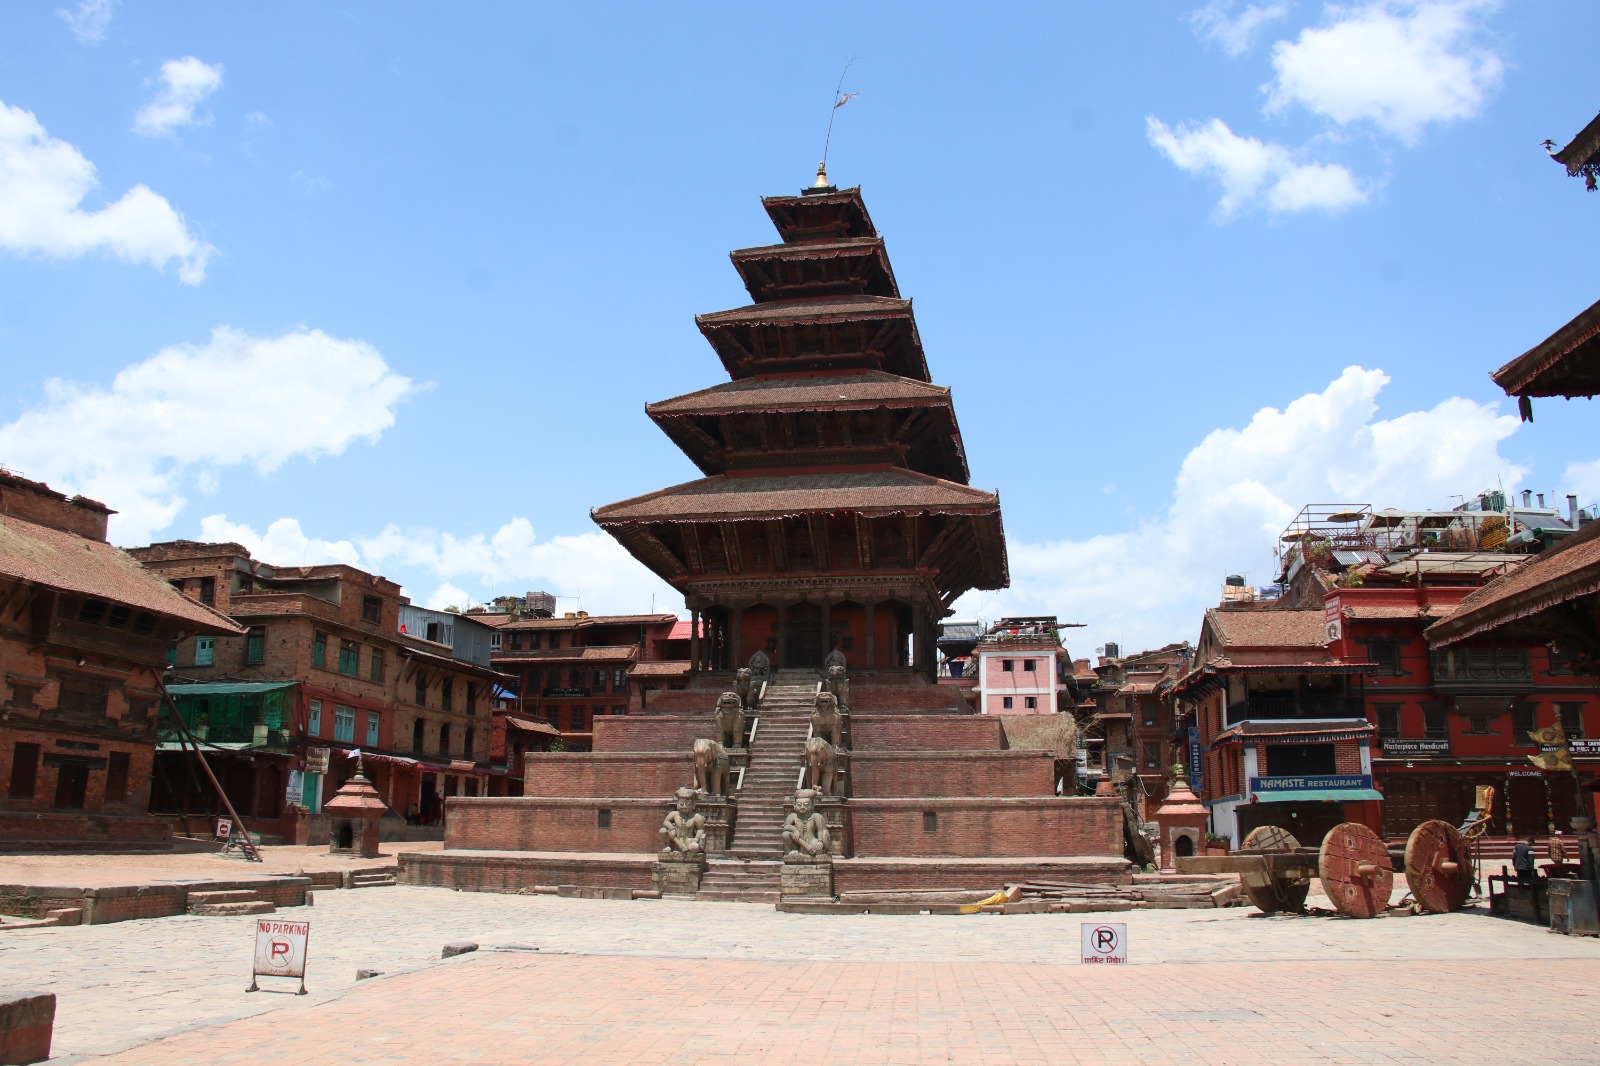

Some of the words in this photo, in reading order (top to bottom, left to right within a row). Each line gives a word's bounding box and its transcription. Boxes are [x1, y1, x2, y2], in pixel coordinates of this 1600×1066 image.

[1383, 743, 1418, 751] Masterpiece
[1260, 778, 1305, 789] NAMASTE
[1307, 779, 1363, 787] RESTAURANT
[258, 922, 271, 933] NO
[272, 923, 307, 936] PARKING
